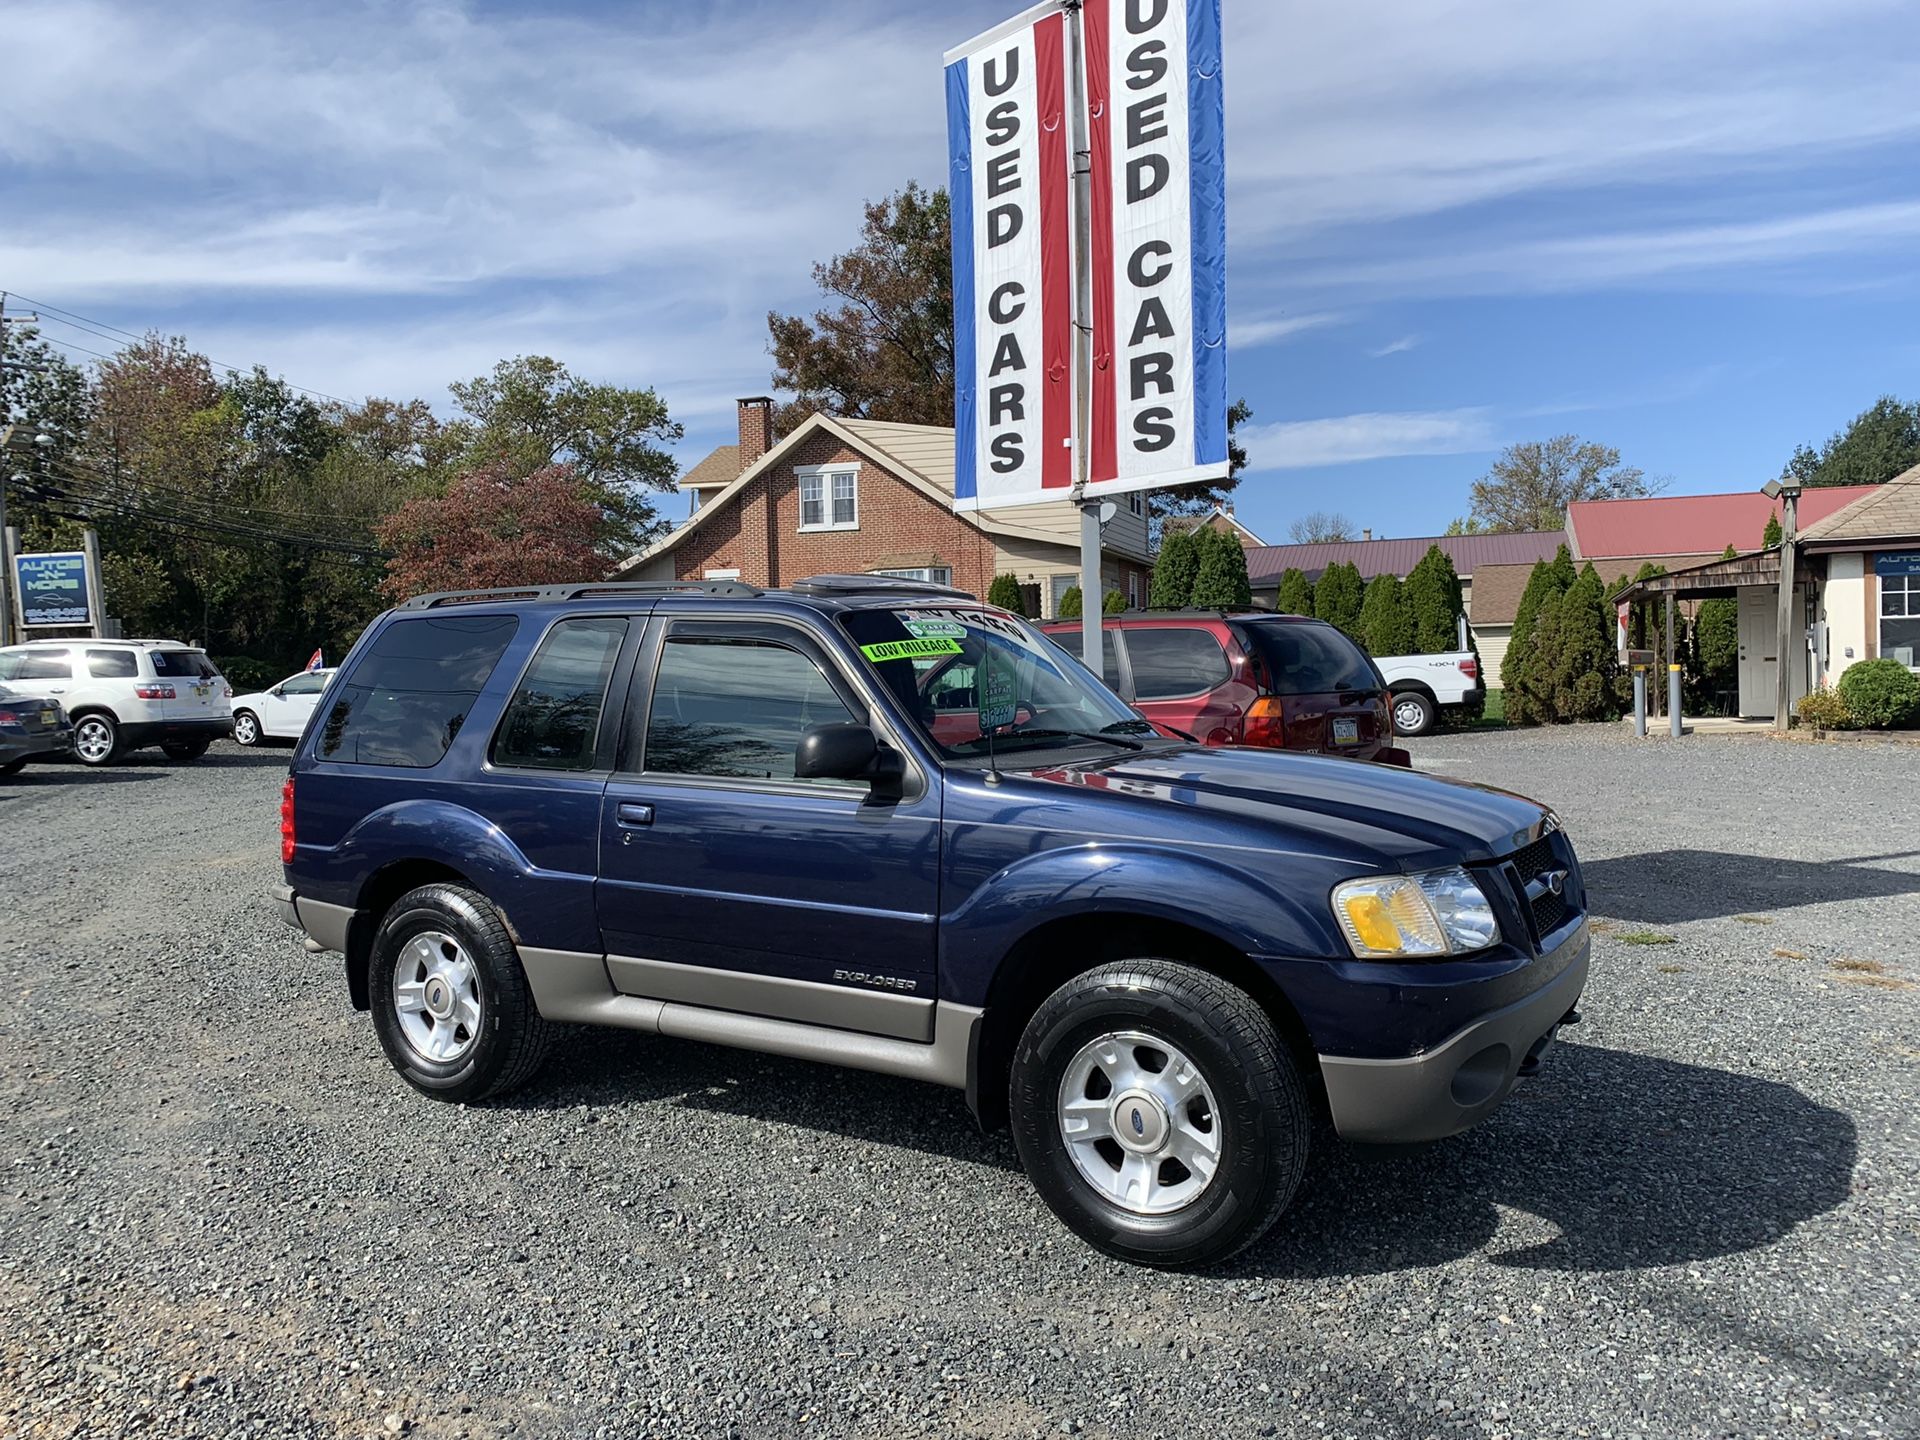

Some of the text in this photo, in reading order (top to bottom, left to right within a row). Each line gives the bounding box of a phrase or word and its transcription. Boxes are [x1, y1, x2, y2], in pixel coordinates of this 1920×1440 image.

[982, 46, 1027, 475] USED CARS
[1124, 0, 1176, 453] USED CARS
[869, 639, 953, 658] LOW MILEAGE
[832, 969, 917, 991] EXPLORER
